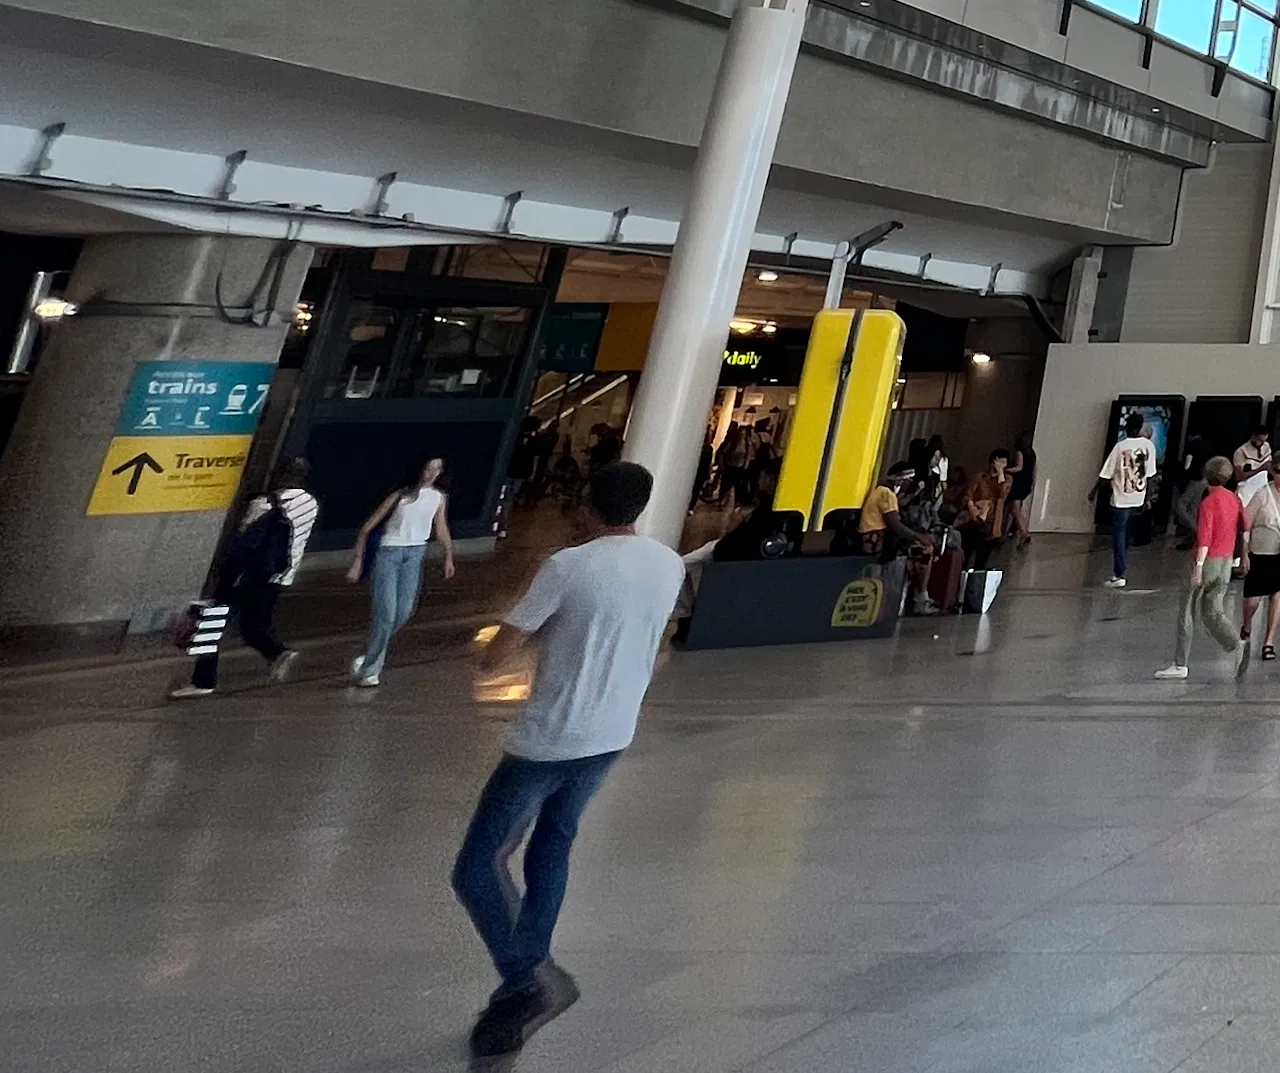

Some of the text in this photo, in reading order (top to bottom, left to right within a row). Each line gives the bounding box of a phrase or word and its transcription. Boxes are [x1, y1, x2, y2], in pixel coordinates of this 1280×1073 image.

[726, 350, 762, 369] daily
[148, 378, 218, 395] trains
[141, 412, 157, 425] A
